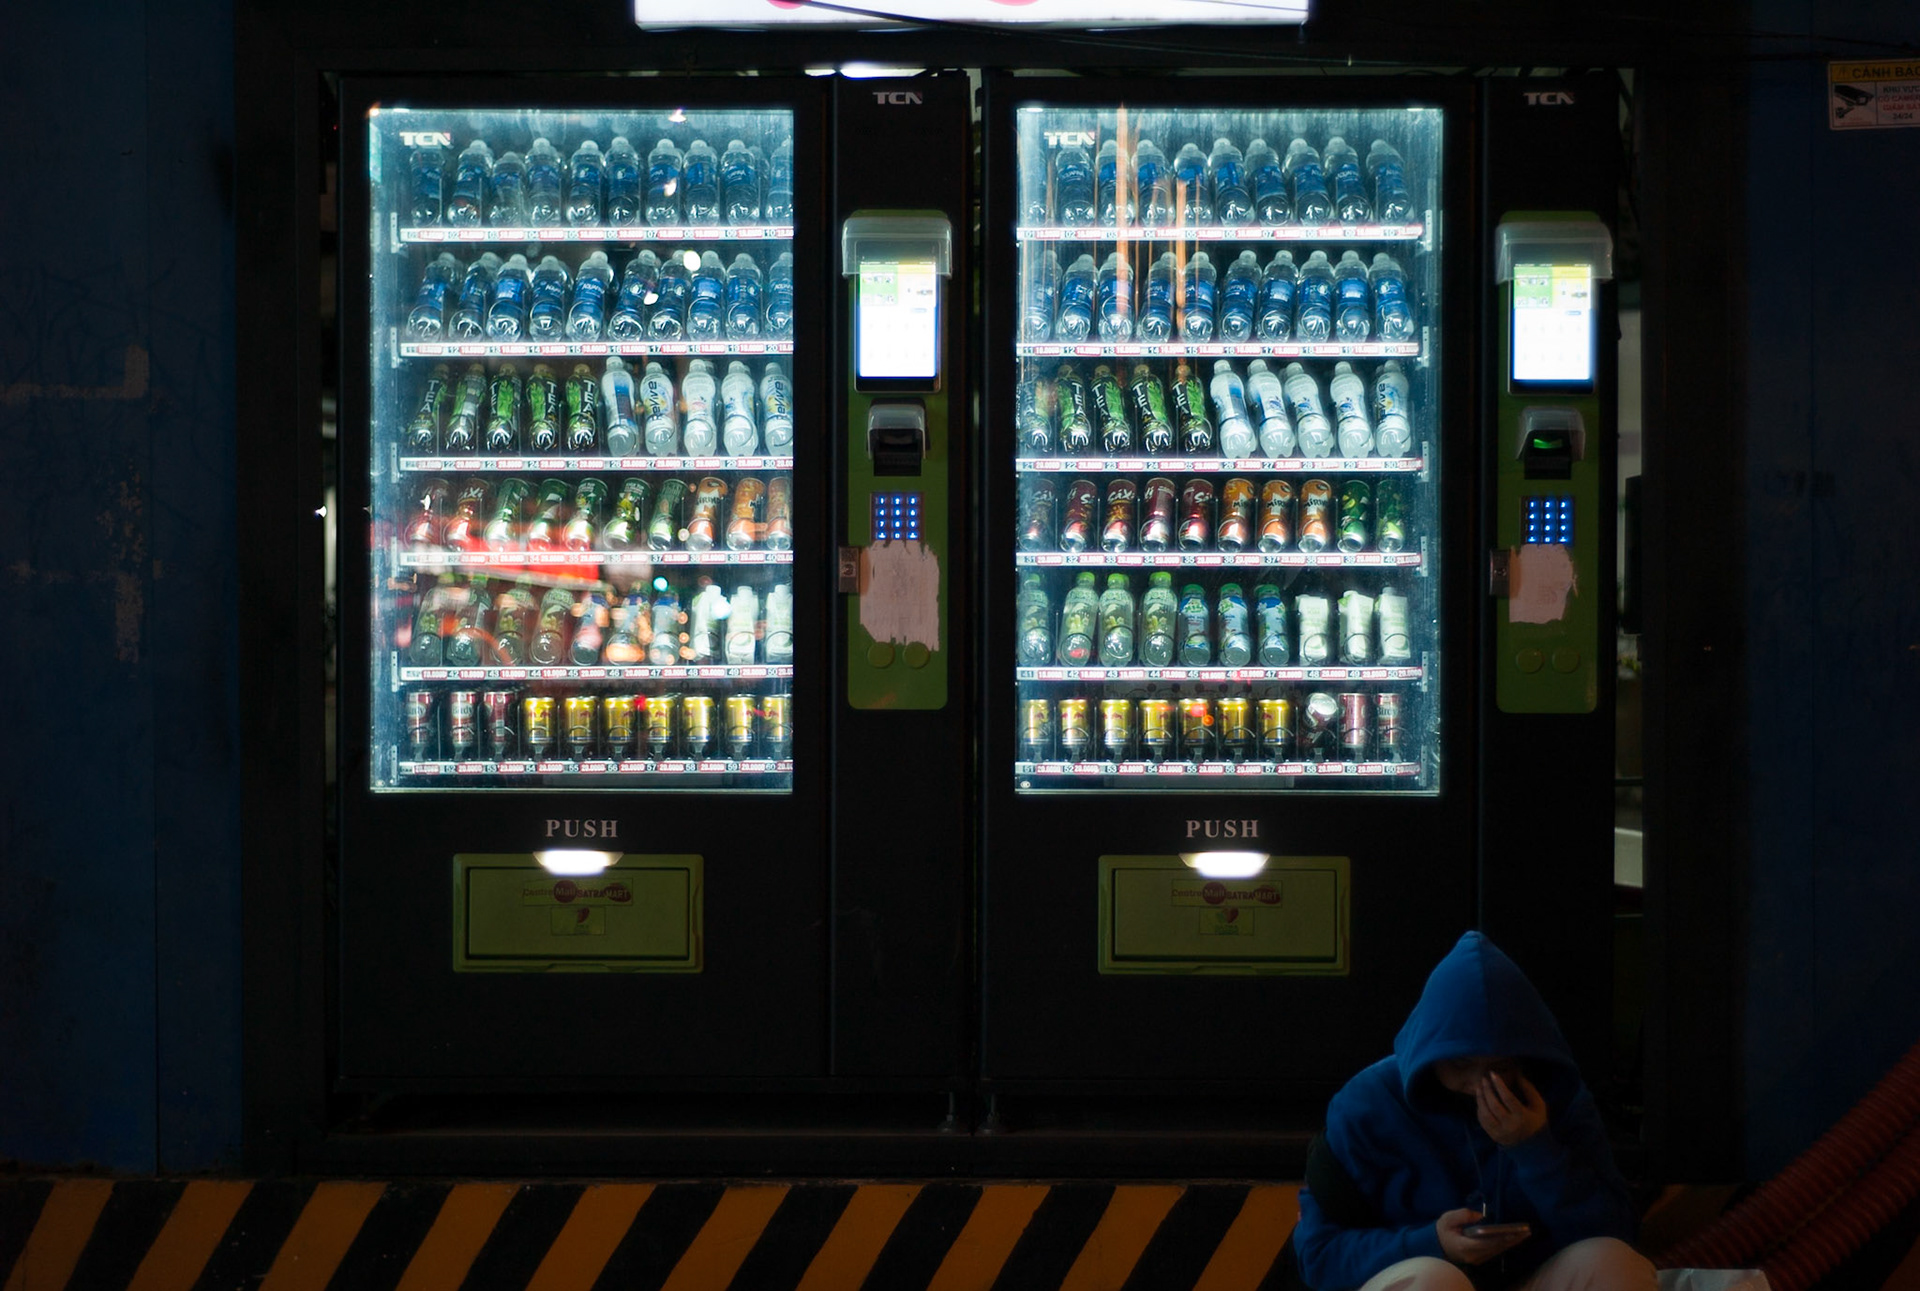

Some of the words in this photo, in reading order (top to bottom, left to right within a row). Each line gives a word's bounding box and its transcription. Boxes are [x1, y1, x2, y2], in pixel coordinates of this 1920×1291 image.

[872, 91, 923, 105] TCN
[1523, 91, 1575, 105] TCN
[399, 132, 451, 146] TCN
[1043, 131, 1095, 147] TCN
[545, 819, 619, 838] PUSH
[1186, 819, 1260, 838] PUSH
